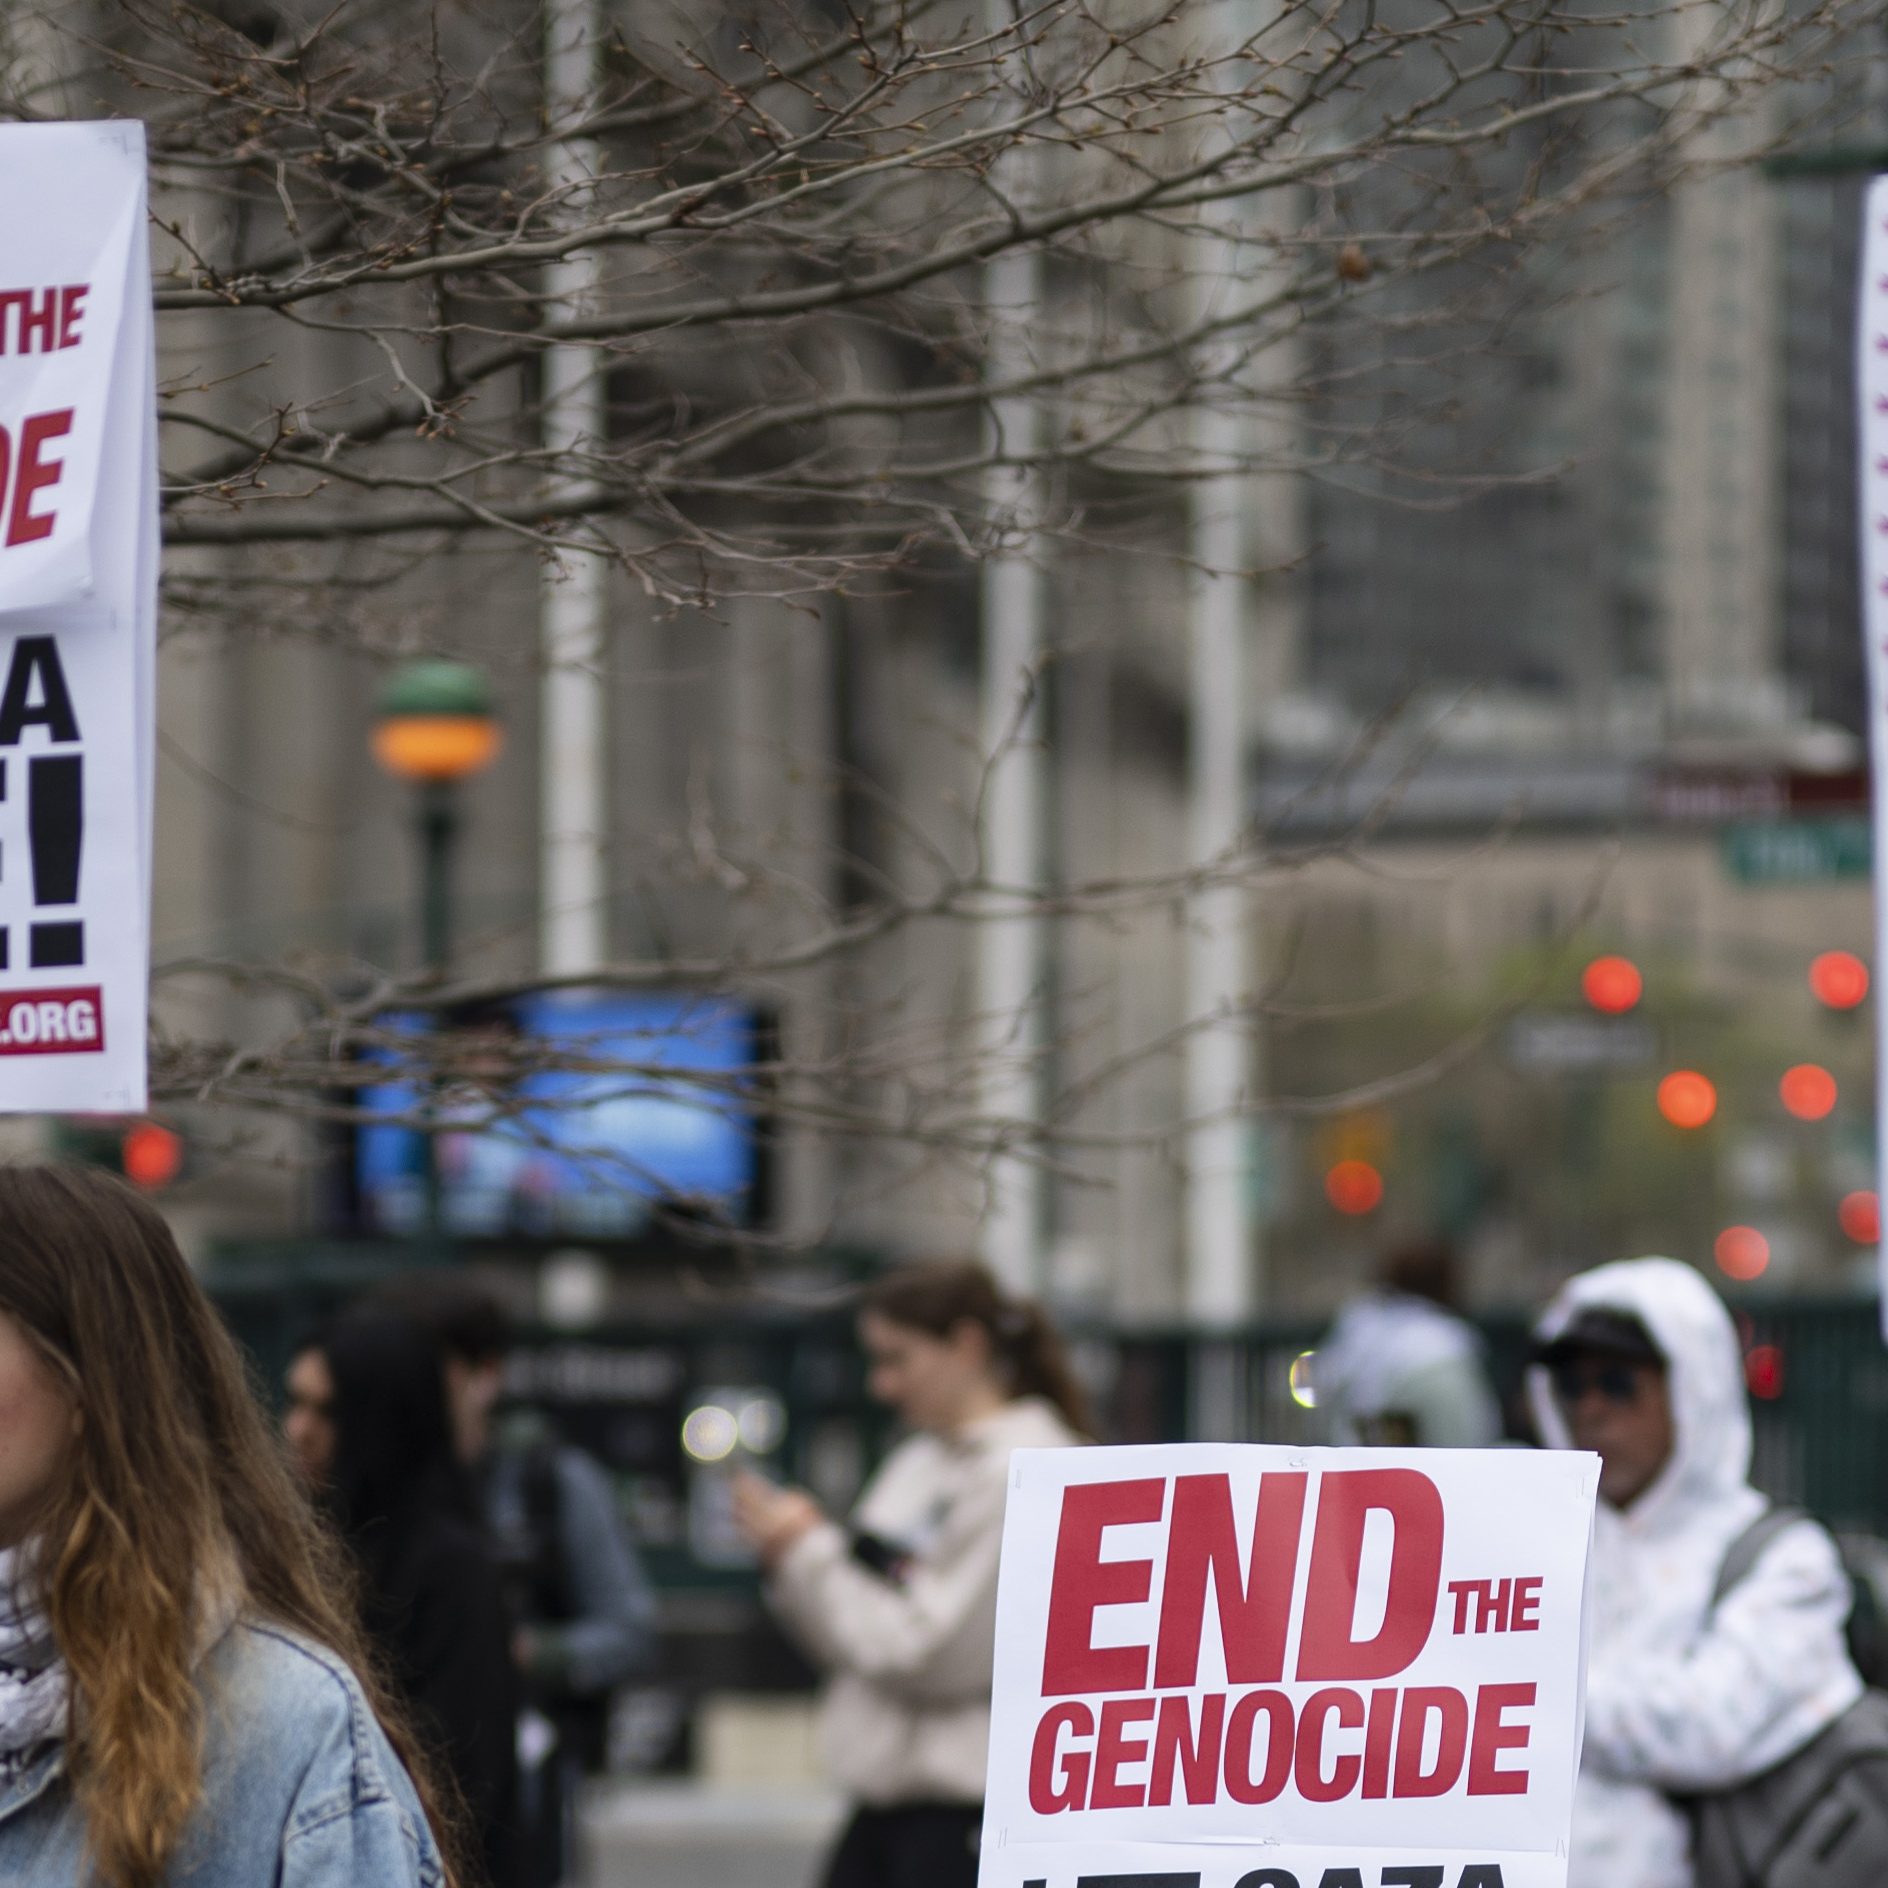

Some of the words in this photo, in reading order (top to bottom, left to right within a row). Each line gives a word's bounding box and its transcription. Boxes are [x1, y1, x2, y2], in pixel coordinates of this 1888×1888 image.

[1041, 1468, 1444, 1696] END
[1447, 1576, 1543, 1634] THE
[1028, 1681, 1537, 1815] GENOCIDE
